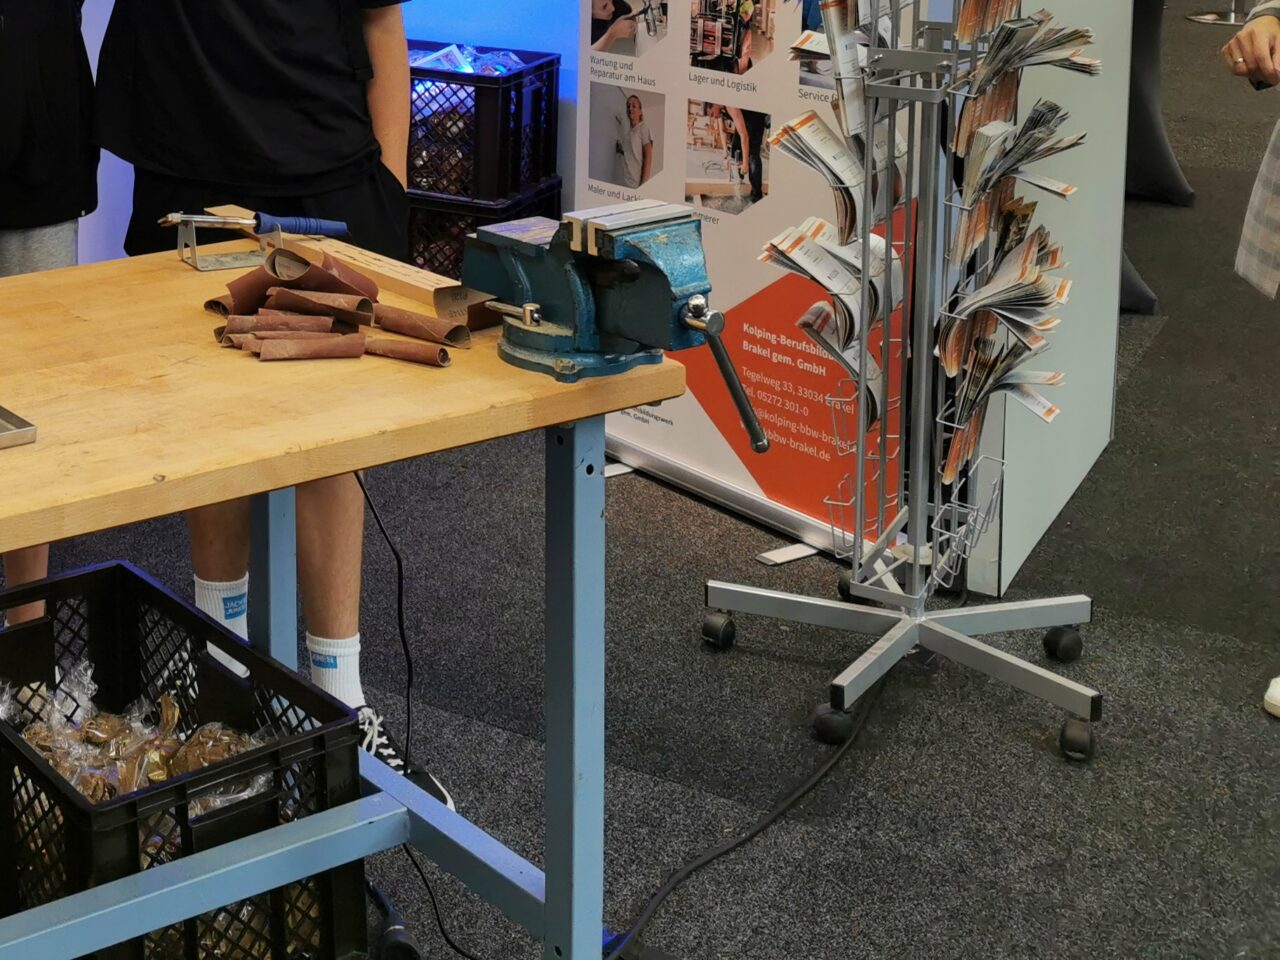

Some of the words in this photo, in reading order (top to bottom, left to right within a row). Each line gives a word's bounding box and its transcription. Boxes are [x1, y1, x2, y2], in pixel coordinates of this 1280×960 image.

[590, 55, 618, 72] Wartung
[619, 61, 634, 71] und
[590, 67, 623, 82] Reparatur
[624, 74, 636, 83] am
[637, 74, 657, 87] Haus
[688, 72, 709, 87] Lager
[710, 76, 725, 88] und
[726, 78, 758, 93] Logistik
[798, 88, 830, 103] Service
[588, 183, 606, 196] Maler
[607, 188, 621, 199] und
[742, 340, 771, 359] Brakel
[772, 352, 795, 367] gem.
[797, 358, 826, 377] GmbH
[742, 366, 781, 391] Tegelweg
[782, 380, 796, 395] 33,
[797, 386, 824, 403] 33034
[757, 390, 783, 407] 05272
[784, 399, 809, 417] 301-0
